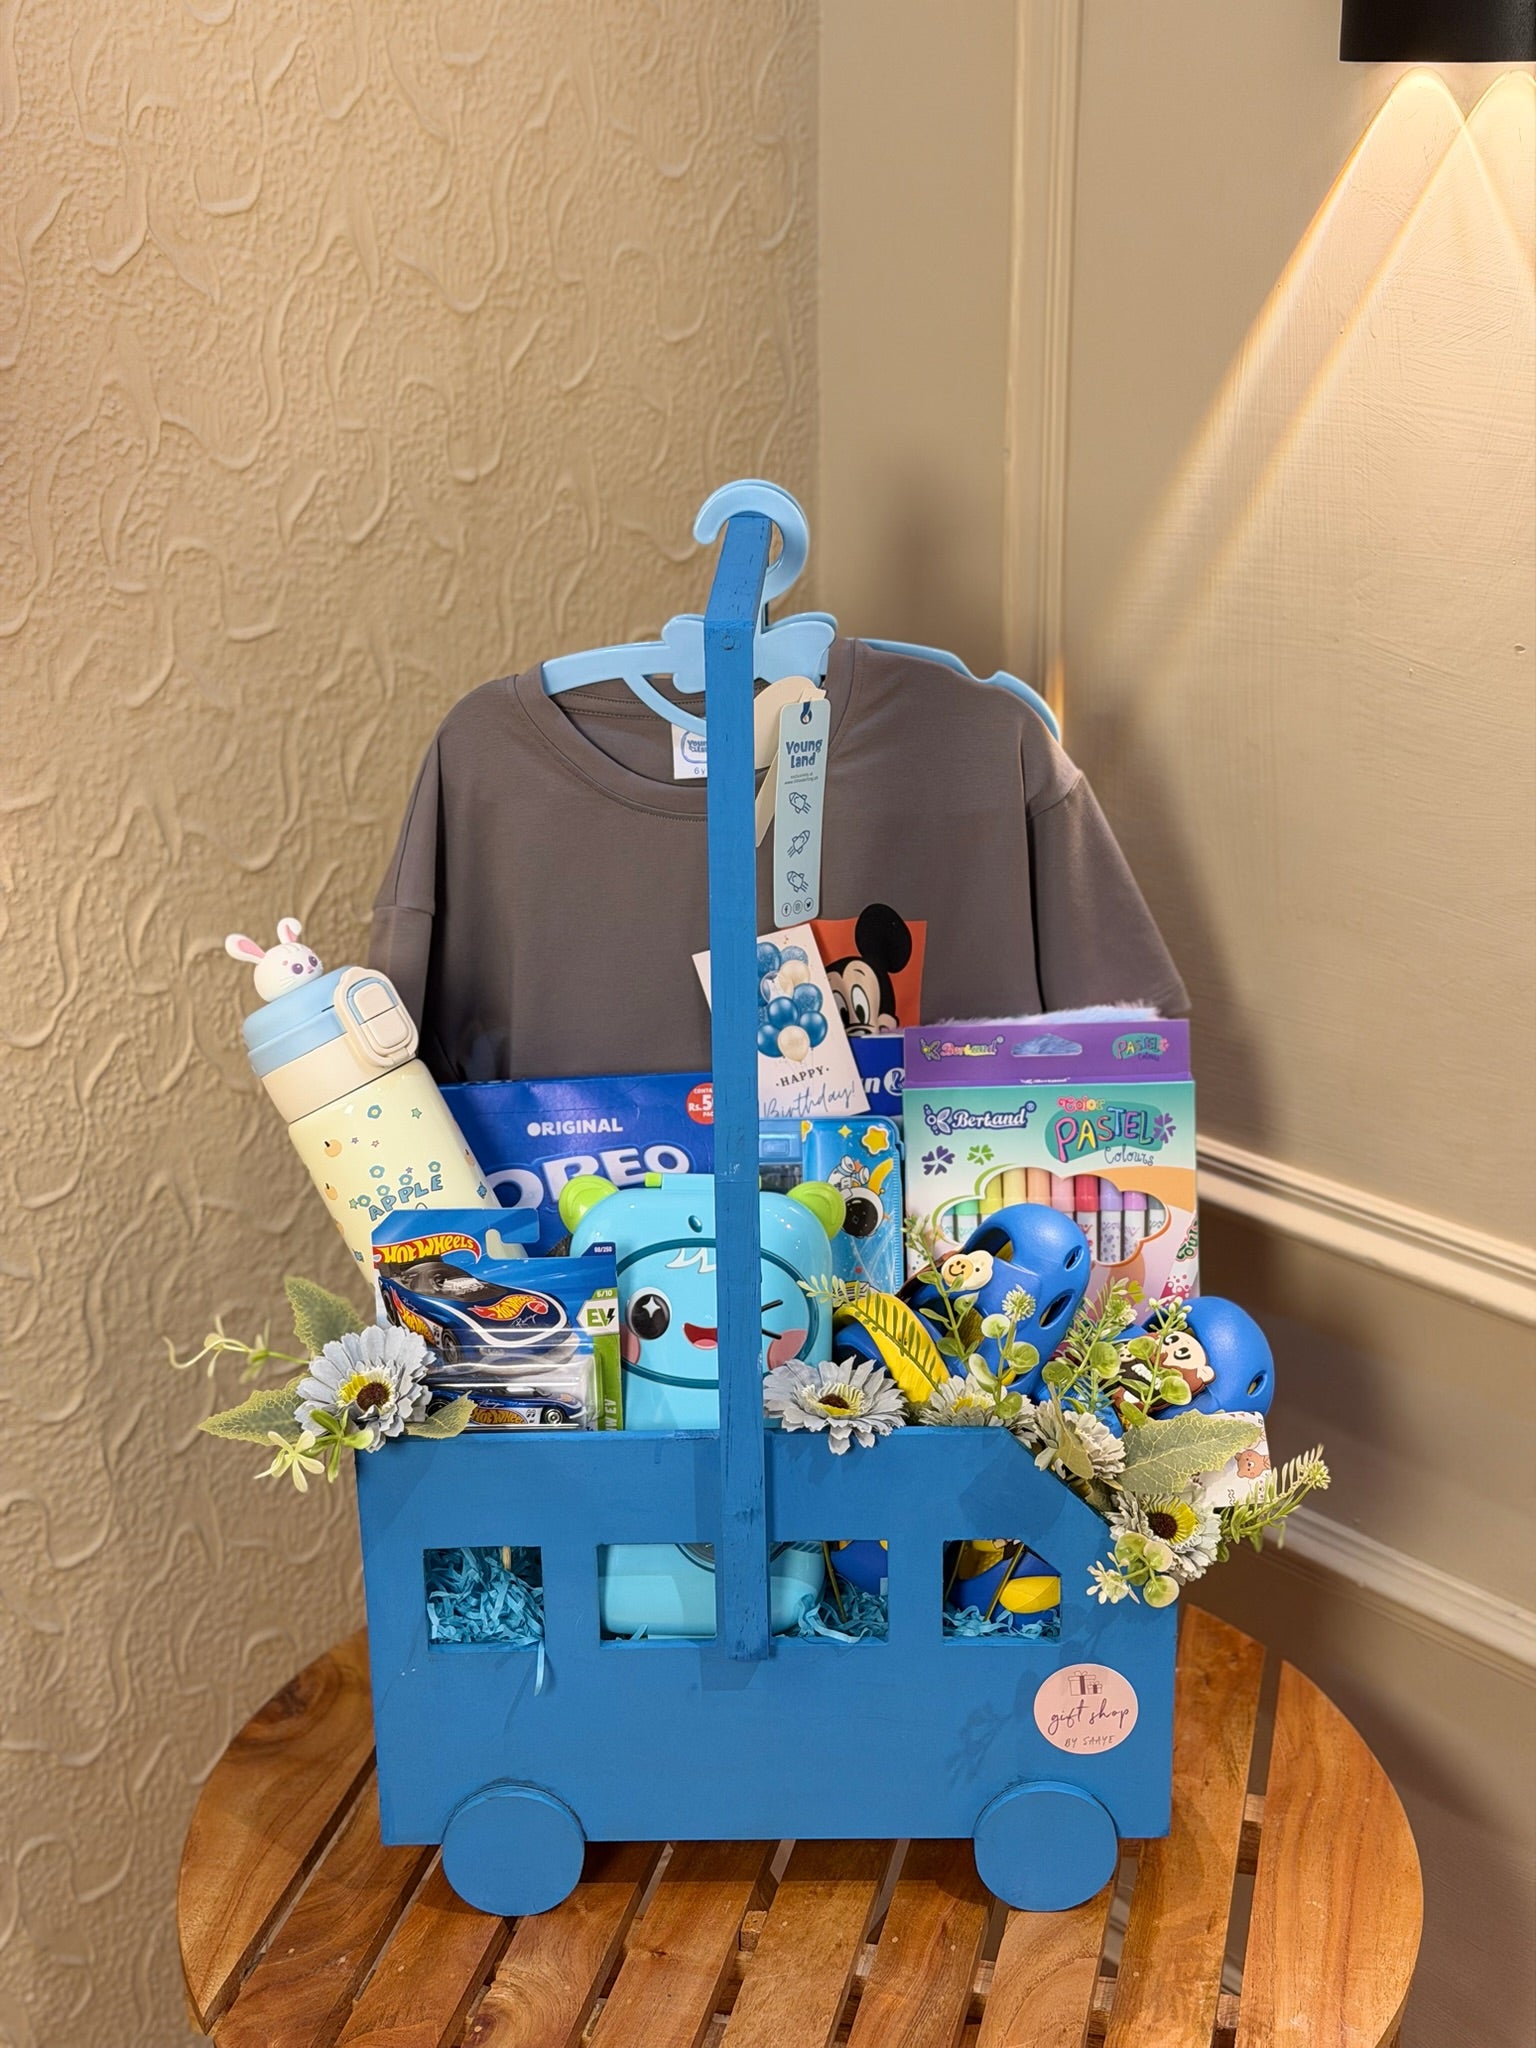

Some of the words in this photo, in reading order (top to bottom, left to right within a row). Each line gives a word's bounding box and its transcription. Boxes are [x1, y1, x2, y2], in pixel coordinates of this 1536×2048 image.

[785, 739, 823, 755] Young
[790, 752, 816, 769] Land
[779, 1065, 825, 1087] HAPPY
[527, 1118, 623, 1137] ORIGINAL
[1055, 1106, 1154, 1163] PASTEL
[1104, 1144, 1154, 1166] Colours
[486, 1144, 690, 1208] OREO
[368, 1173, 444, 1222] APPLE
[586, 1308, 615, 1327] EV
[1047, 1698, 1090, 1736] gift
[1088, 1697, 1130, 1729] shop
[1064, 1738, 1079, 1748] BY
